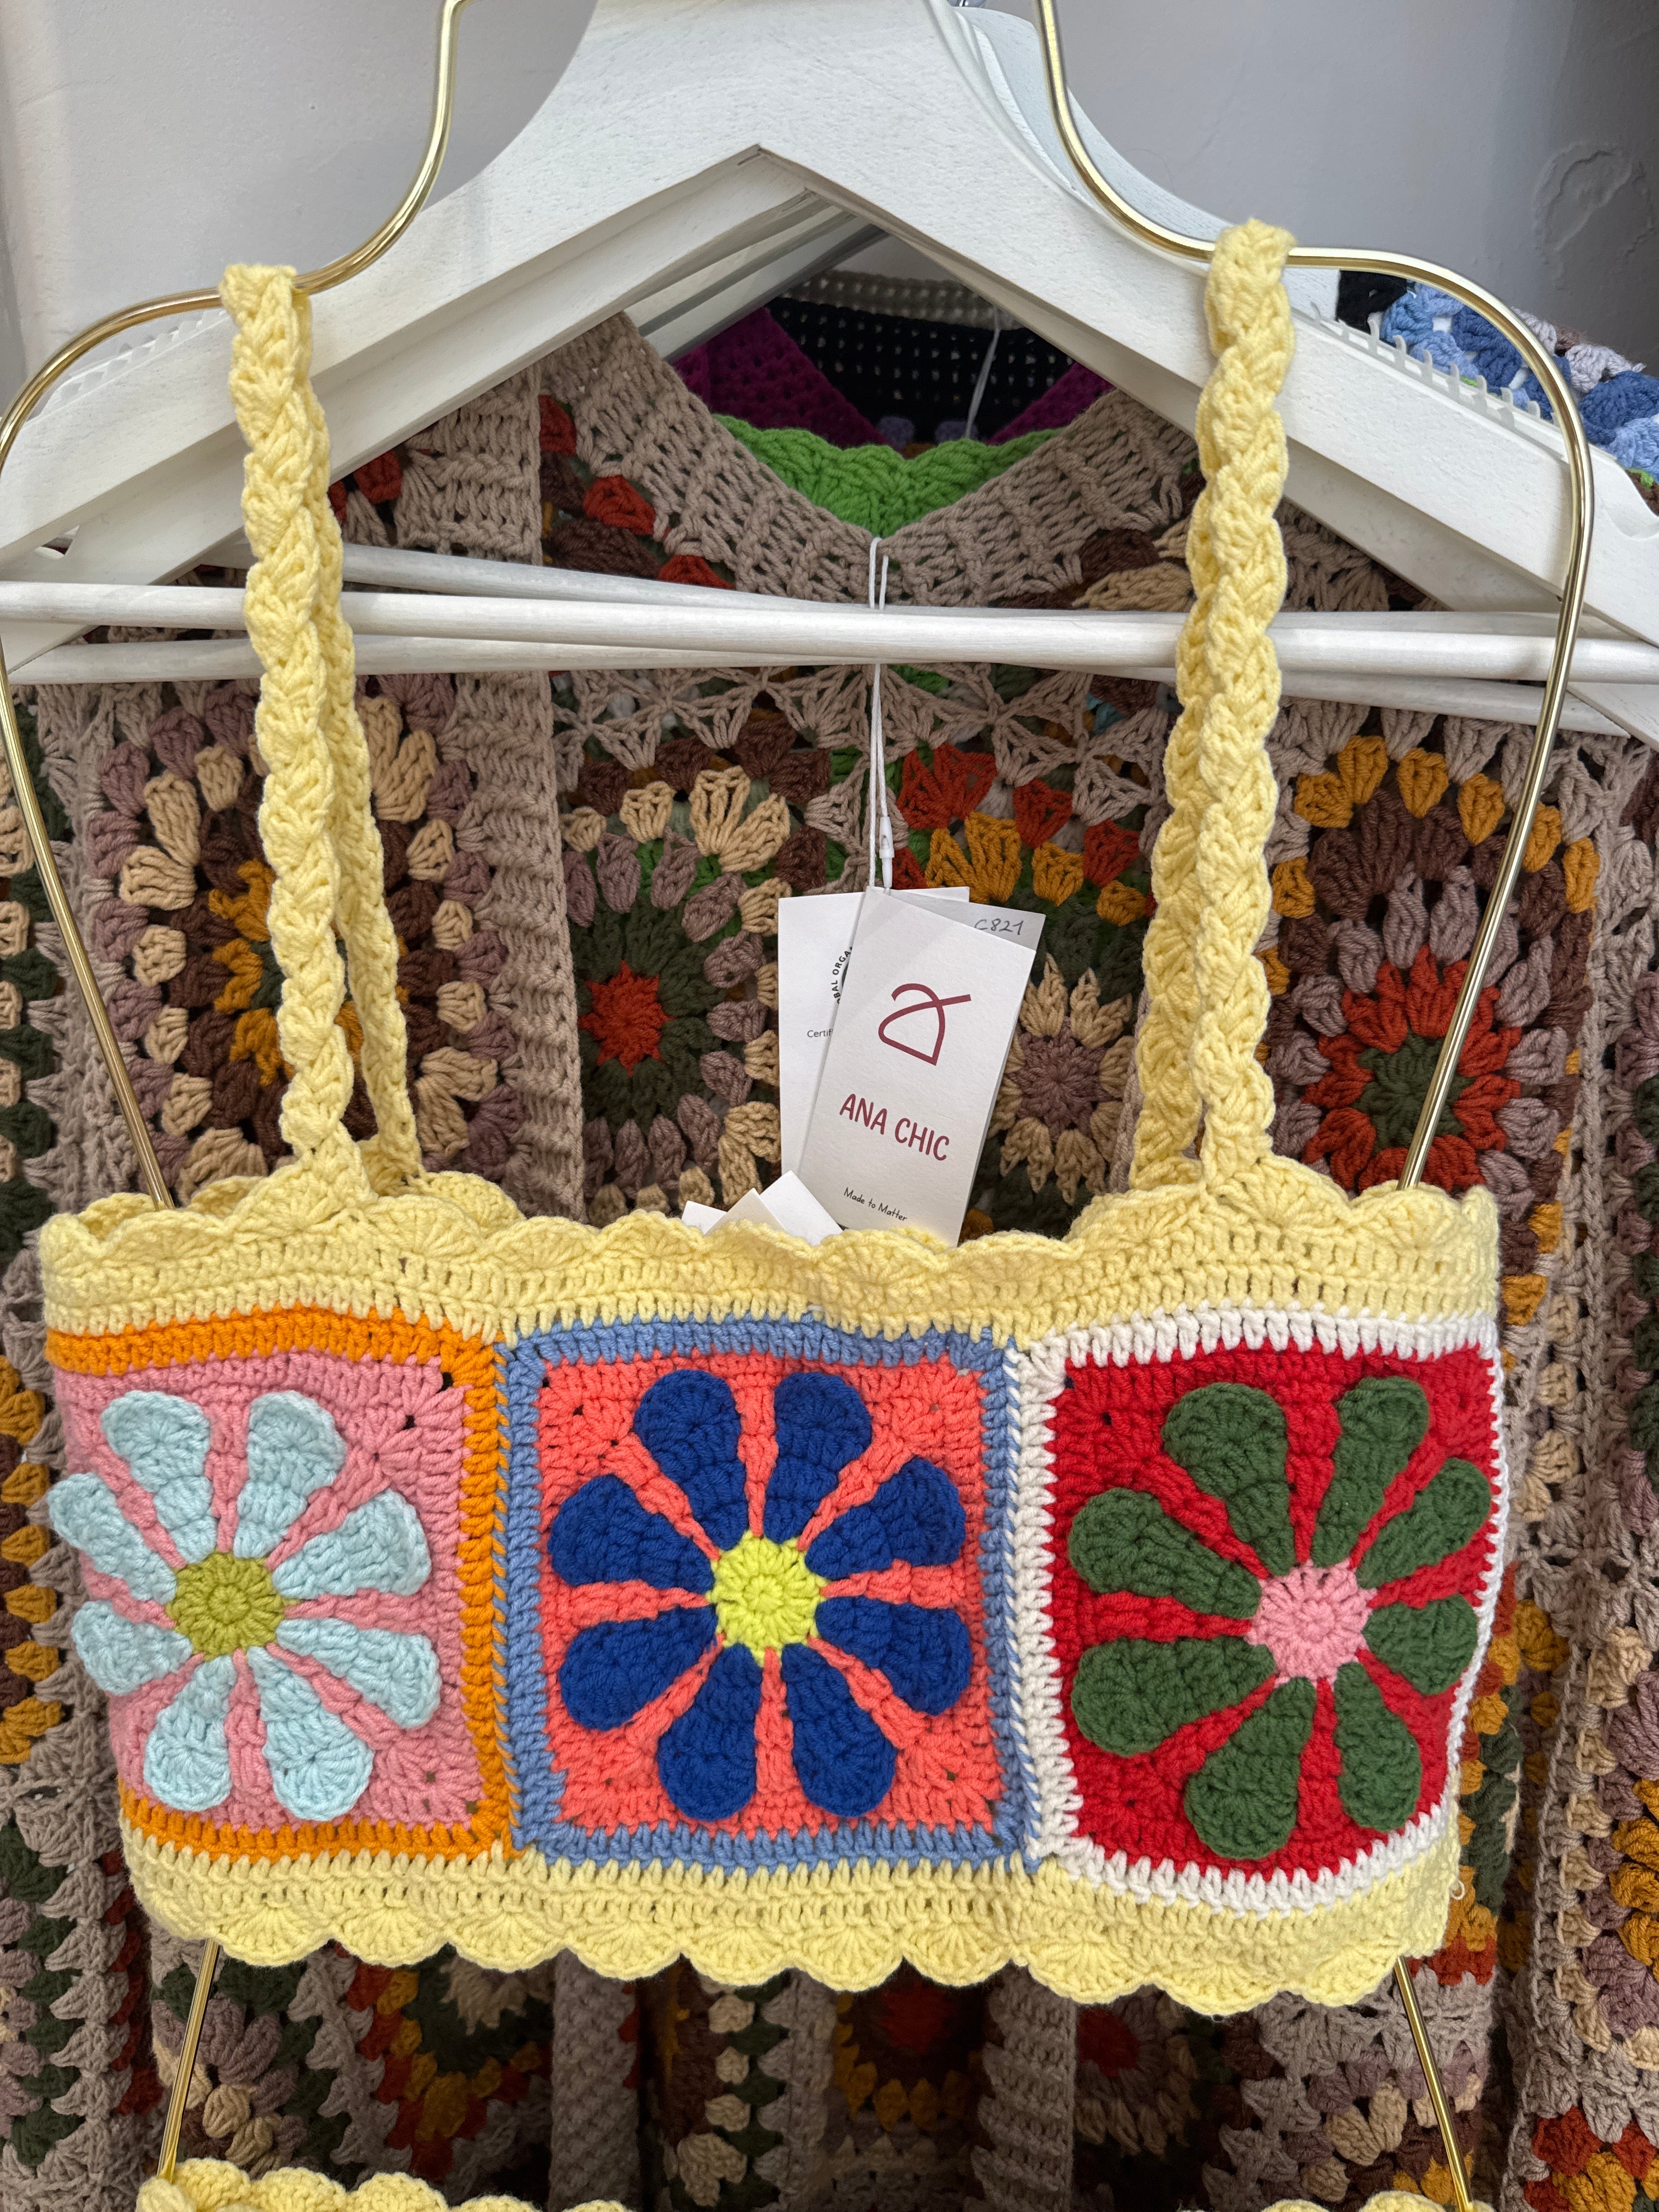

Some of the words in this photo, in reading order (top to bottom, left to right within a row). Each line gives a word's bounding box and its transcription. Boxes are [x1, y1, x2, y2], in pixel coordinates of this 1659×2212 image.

[974, 918, 1024, 935] C821
[832, 946, 853, 975] ORGA
[839, 1093, 888, 1135] ANA
[895, 1118, 950, 1161] CHIC
[844, 1187, 865, 1204] Made
[868, 1198, 876, 1208] to
[878, 1203, 907, 1221] Matter
